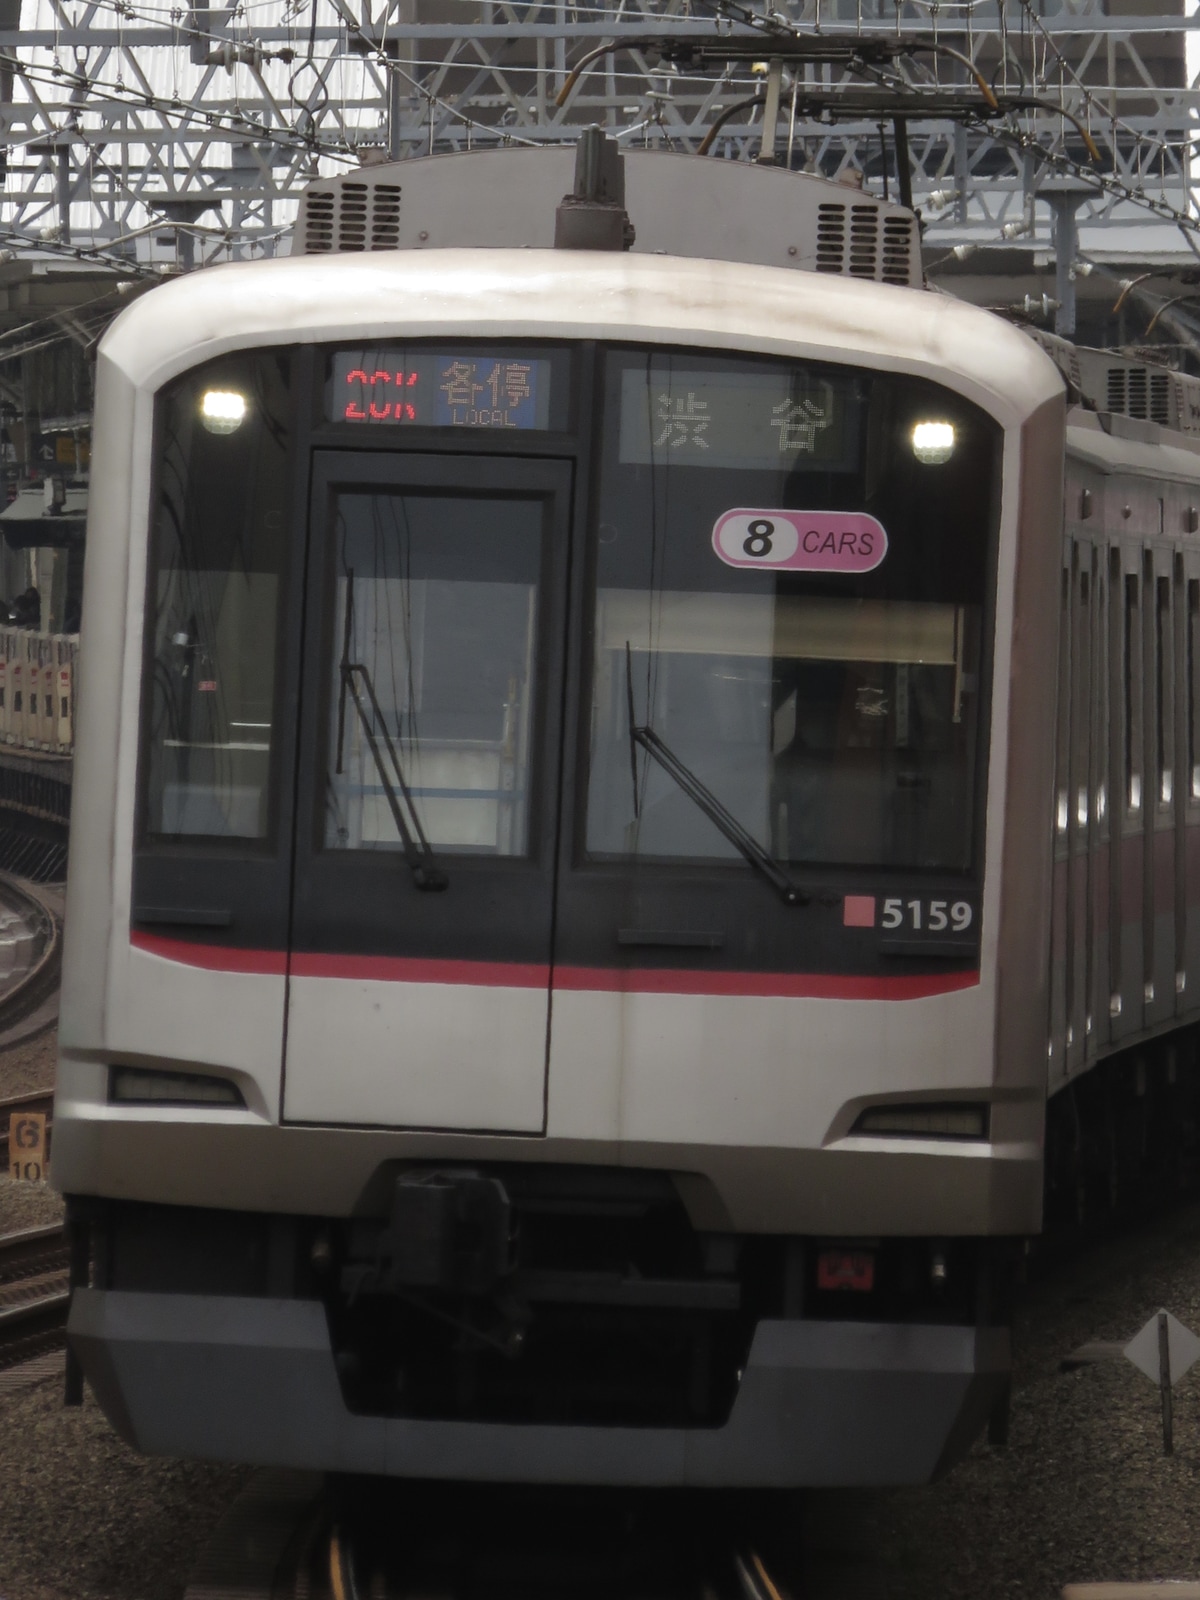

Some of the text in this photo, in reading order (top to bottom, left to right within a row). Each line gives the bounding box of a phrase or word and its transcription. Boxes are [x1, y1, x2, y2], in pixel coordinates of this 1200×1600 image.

[440, 361, 530, 407] 各停
[453, 408, 516, 426] LOCAL
[743, 519, 874, 557] 8 CARS
[881, 898, 973, 931] 5159
[13, 1162, 41, 1180] 10
